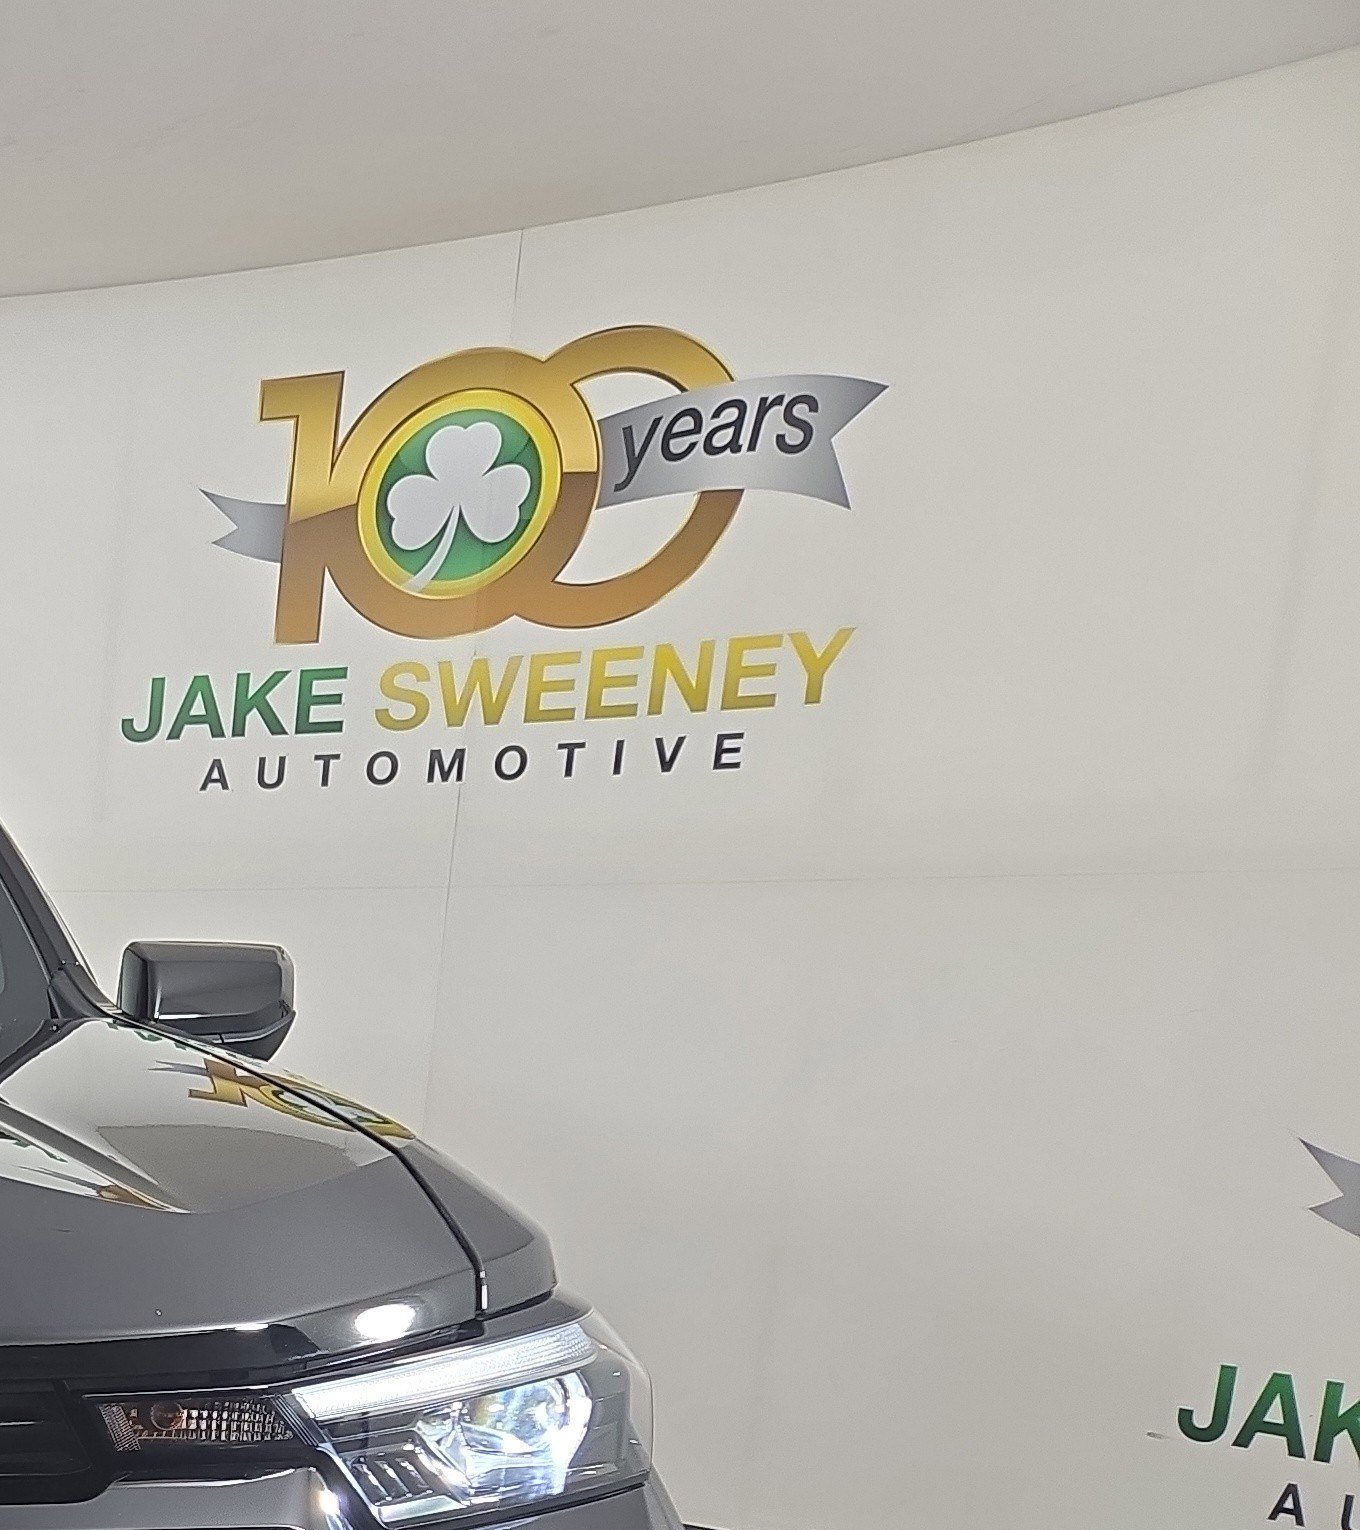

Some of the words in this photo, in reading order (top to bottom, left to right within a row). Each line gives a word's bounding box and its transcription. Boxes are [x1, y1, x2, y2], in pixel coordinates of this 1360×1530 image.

[613, 391, 819, 493] years
[121, 666, 349, 742] JAKE
[374, 627, 856, 731] SWEENEY
[200, 731, 745, 791] AUTOMOTIVE
